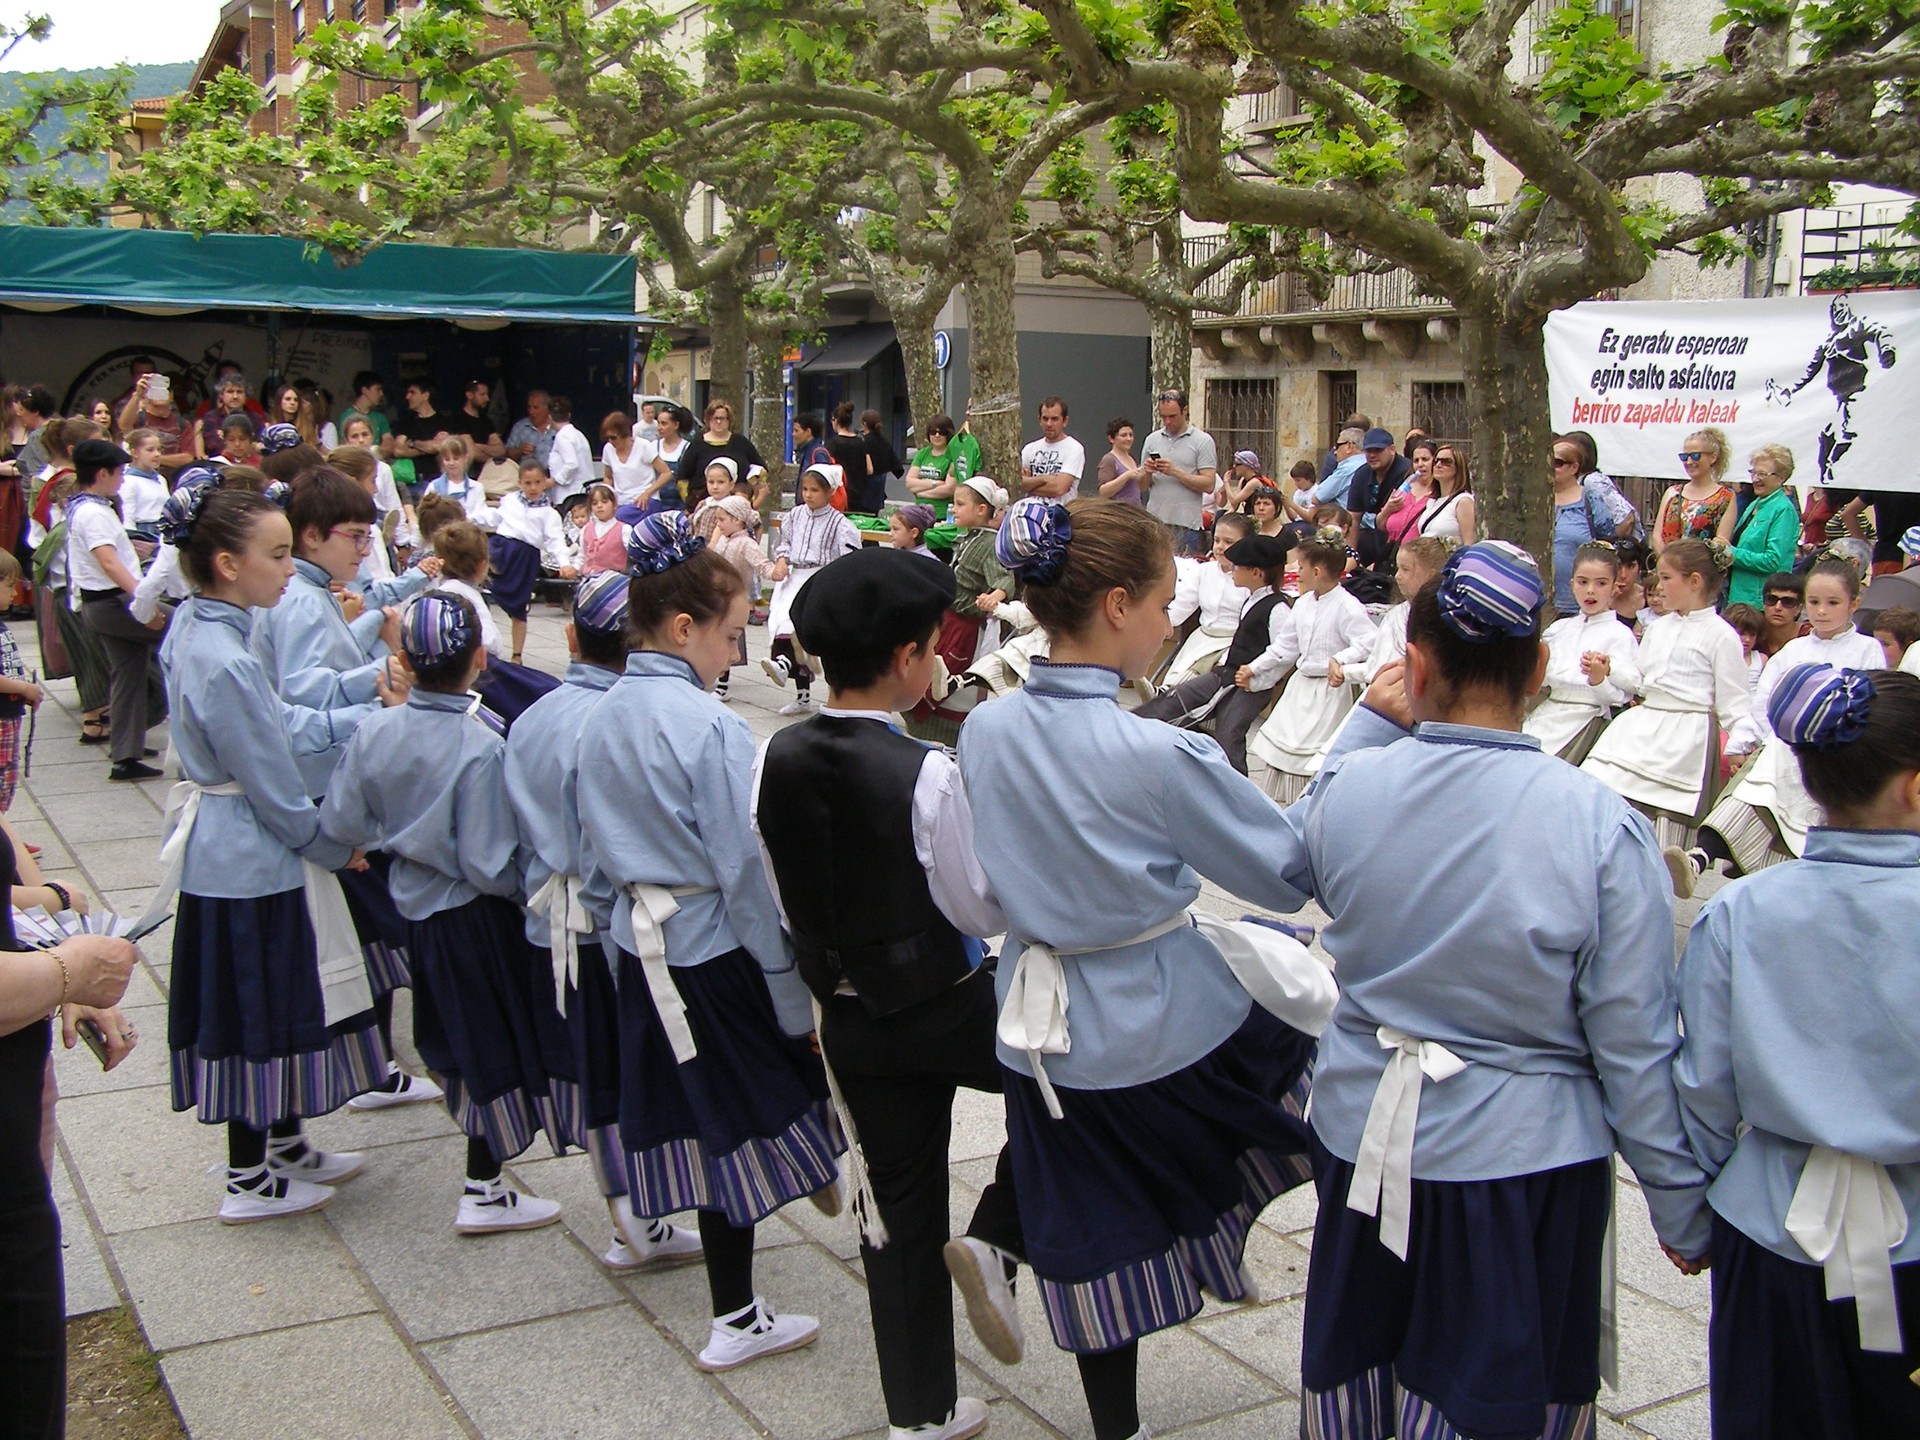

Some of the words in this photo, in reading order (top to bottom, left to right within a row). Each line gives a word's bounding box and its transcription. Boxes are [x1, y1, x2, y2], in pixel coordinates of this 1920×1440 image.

[1598, 327, 1620, 353] Ez
[1618, 329, 1674, 360] geratu
[1675, 335, 1749, 360] esperoan
[1590, 362, 1625, 395] egin
[1627, 363, 1665, 390] salto
[1668, 362, 1737, 391] asfaltora
[1572, 396, 1621, 424] berriro
[1623, 397, 1686, 430] zapaldu
[1686, 398, 1740, 424] kaleak
